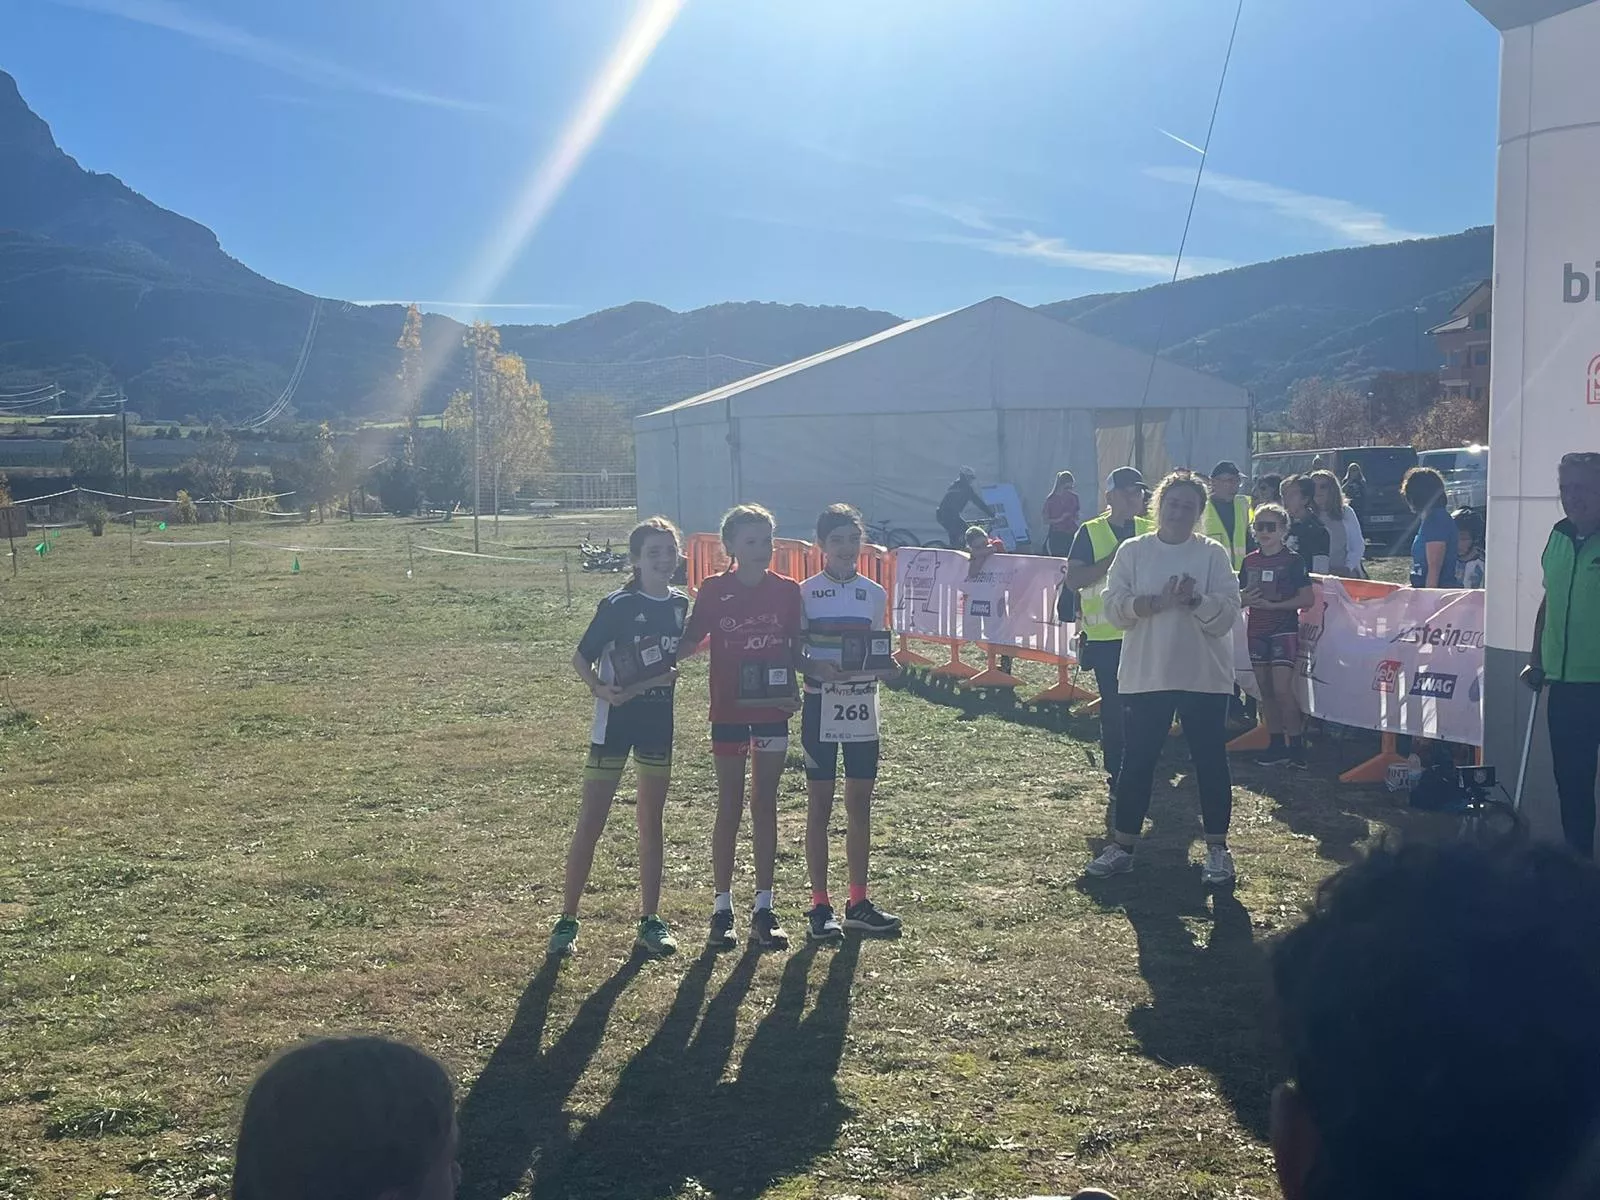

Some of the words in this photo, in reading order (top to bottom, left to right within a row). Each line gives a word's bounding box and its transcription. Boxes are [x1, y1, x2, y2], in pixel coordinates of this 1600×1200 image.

[815, 588, 837, 599] UCI
[1413, 677, 1454, 694] SWAG
[833, 703, 870, 721] 268
